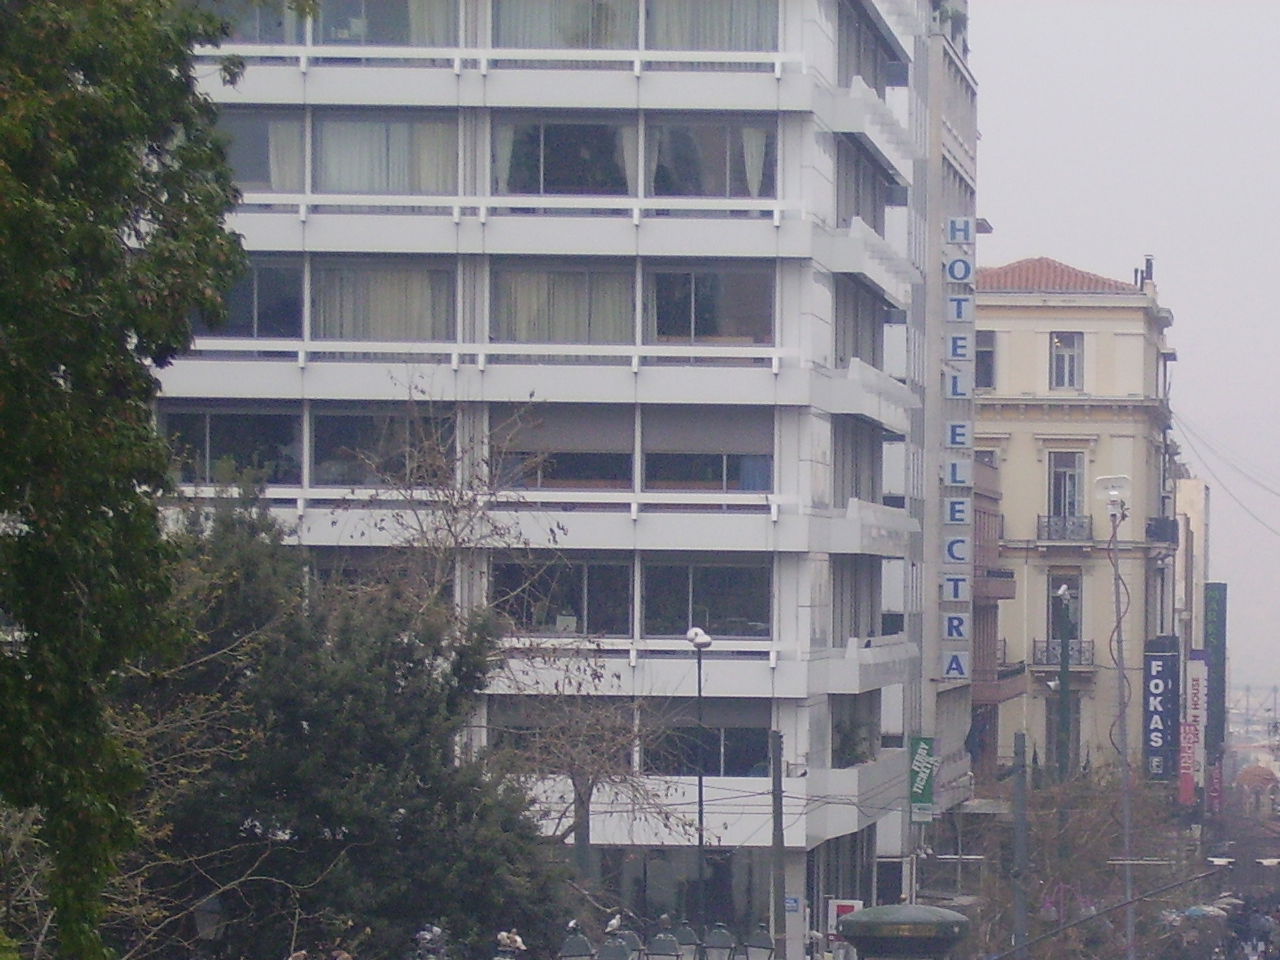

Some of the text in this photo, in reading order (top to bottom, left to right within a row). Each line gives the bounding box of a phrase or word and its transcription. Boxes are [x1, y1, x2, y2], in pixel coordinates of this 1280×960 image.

[945, 219, 972, 676] HOTEL ELECTRA
[1150, 660, 1164, 748] FOKAS
[1191, 677, 1200, 711] HOUSE
[911, 741, 929, 772] FERRY
